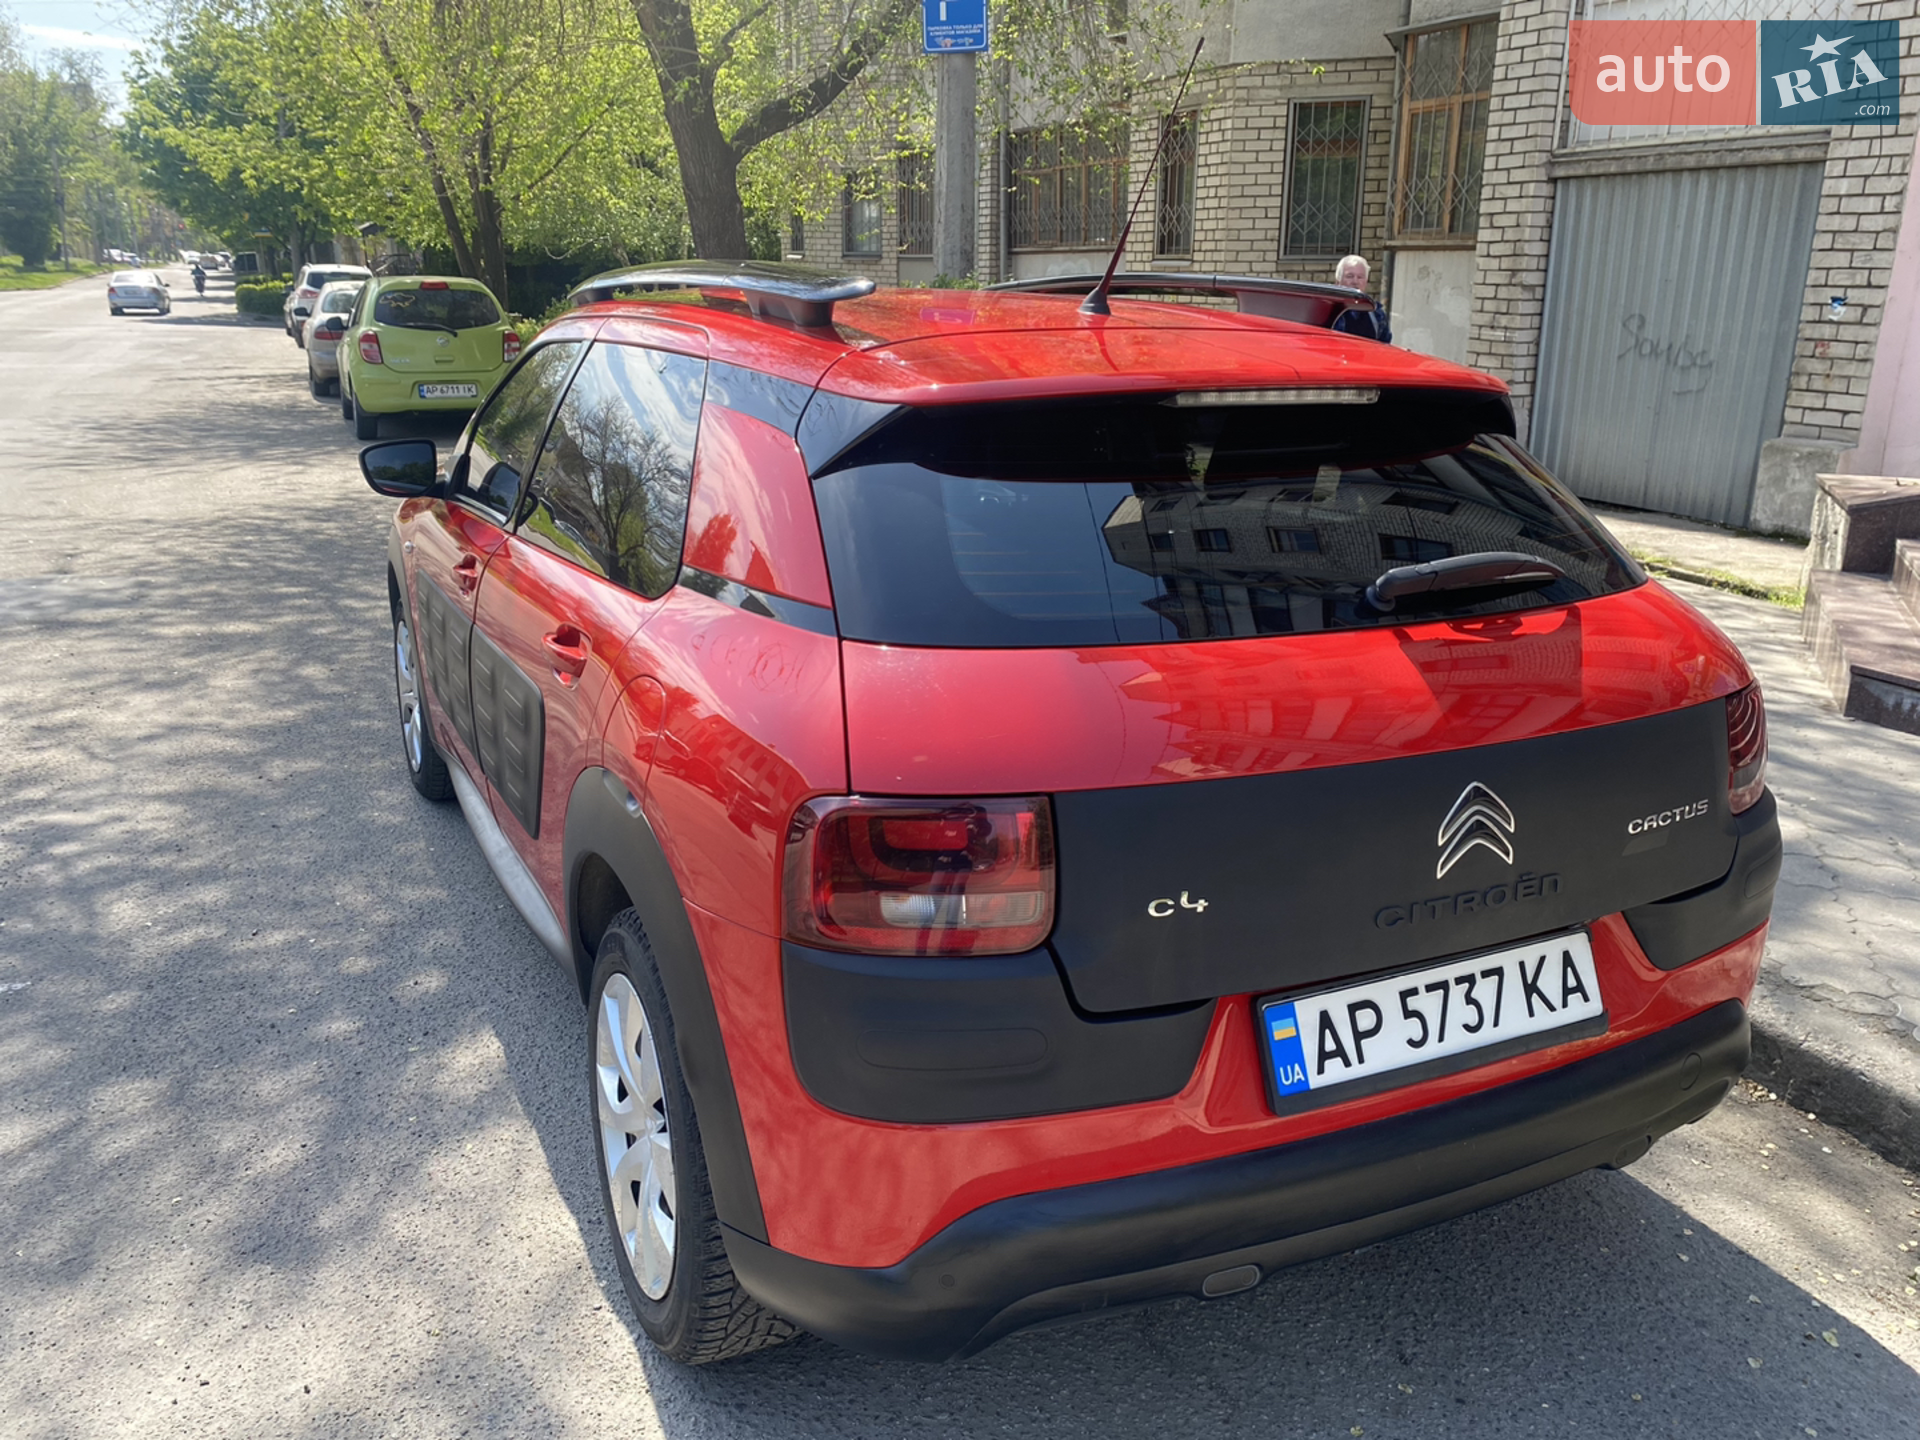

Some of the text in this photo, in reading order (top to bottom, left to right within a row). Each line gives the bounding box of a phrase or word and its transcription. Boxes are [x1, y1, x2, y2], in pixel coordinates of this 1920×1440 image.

[426, 385, 474, 394] AP 6711 IK
[1627, 798, 1709, 835] CACTUS
[1147, 890, 1209, 917] C4
[1316, 949, 1591, 1077] AP 5737 KA
[1279, 1062, 1306, 1086] UA
